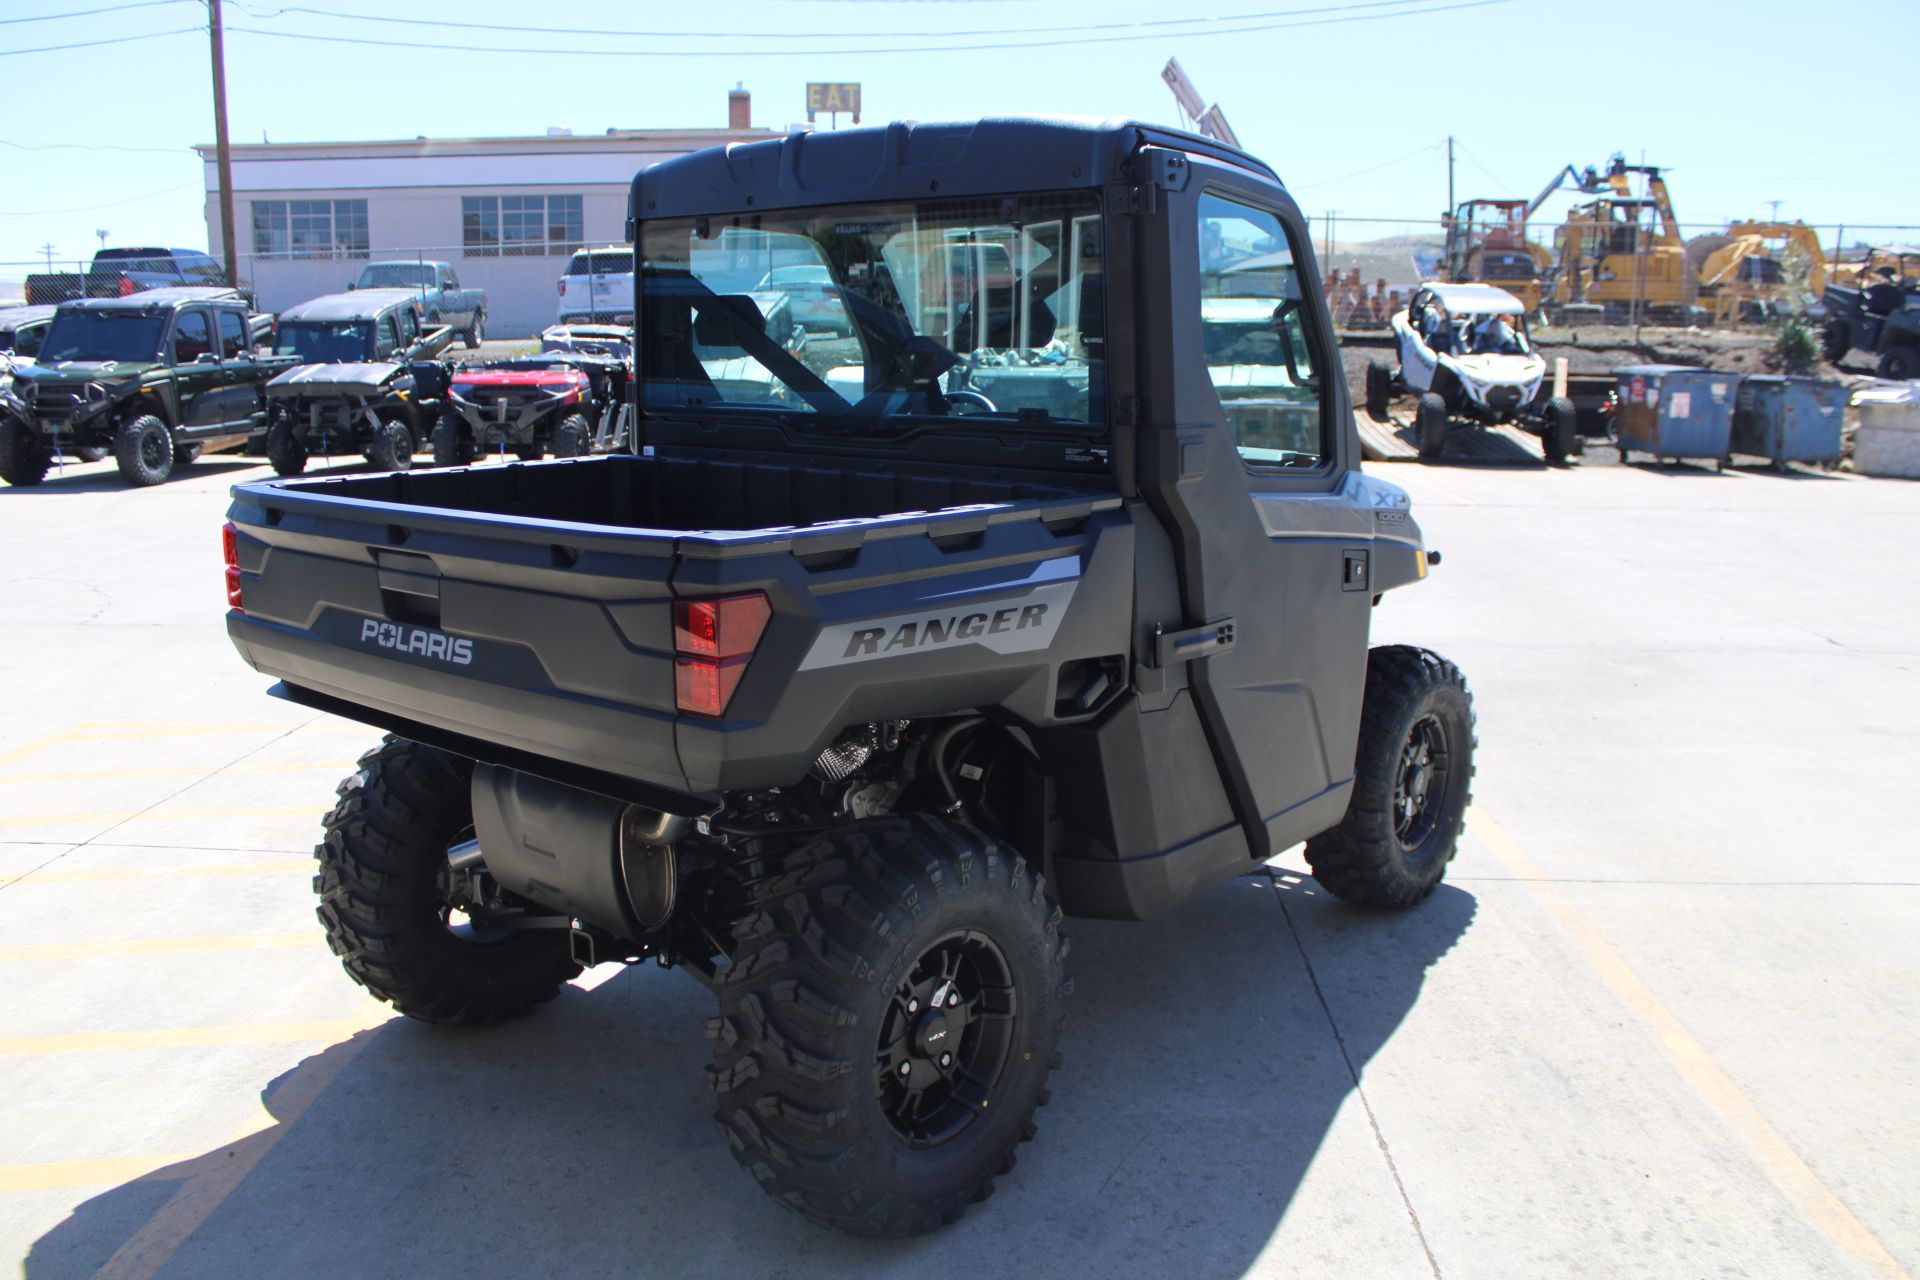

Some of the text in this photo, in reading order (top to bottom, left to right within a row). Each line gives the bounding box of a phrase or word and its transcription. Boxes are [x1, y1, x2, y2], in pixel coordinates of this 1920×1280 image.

[809, 84, 858, 108] EAT
[1374, 491, 1406, 507] XP
[1378, 511, 1404, 521] 1000
[361, 618, 473, 665] POLARIS
[843, 602, 1049, 658] RANGER
